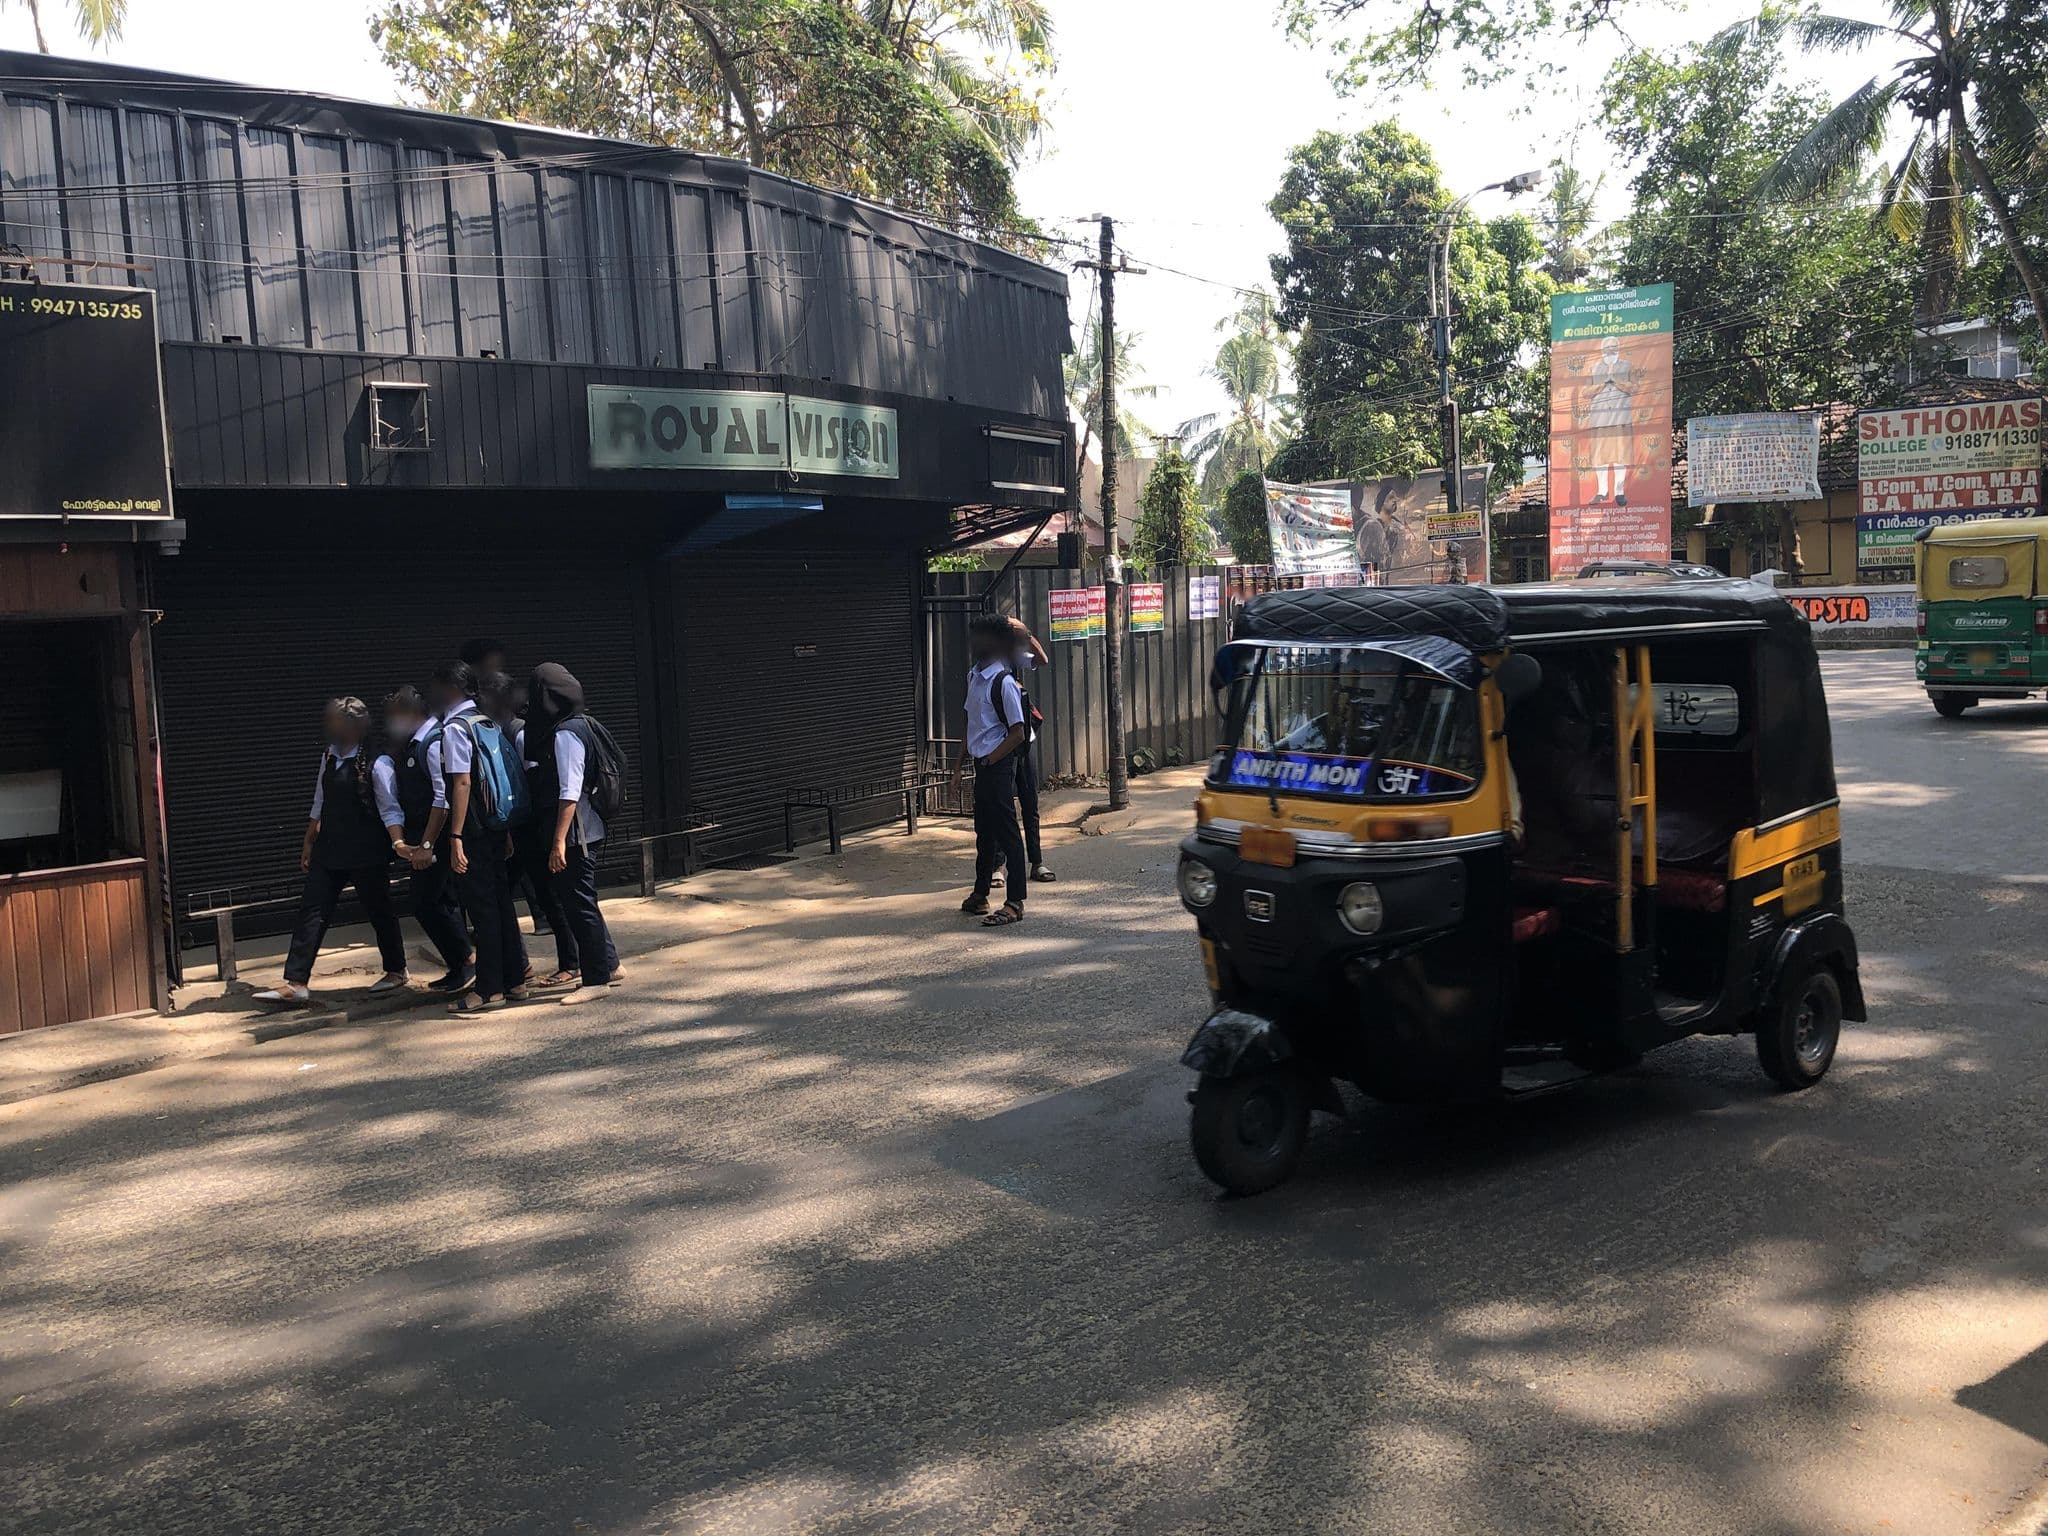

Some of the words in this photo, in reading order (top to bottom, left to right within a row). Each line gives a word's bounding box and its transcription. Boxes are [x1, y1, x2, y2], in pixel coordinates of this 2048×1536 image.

[31, 298, 142, 319] 9947135735
[607, 402, 781, 455] ROYAL
[1860, 402, 2040, 440] St.THOMAS
[1860, 439, 1927, 456] COLLEGE
[1945, 429, 2039, 451] 9188711330
[1862, 480, 1919, 497] B.Com,
[1923, 475, 1986, 493] M.Com,
[1989, 470, 2038, 488] M.B.A
[1862, 495, 1906, 513] B.A,
[1973, 487, 2038, 506] B.B.A
[1860, 556, 1881, 566] EARLY
[1882, 555, 1914, 564] MORNING
[1792, 596, 1869, 623] KPSTA
[1310, 765, 1361, 786] MON
